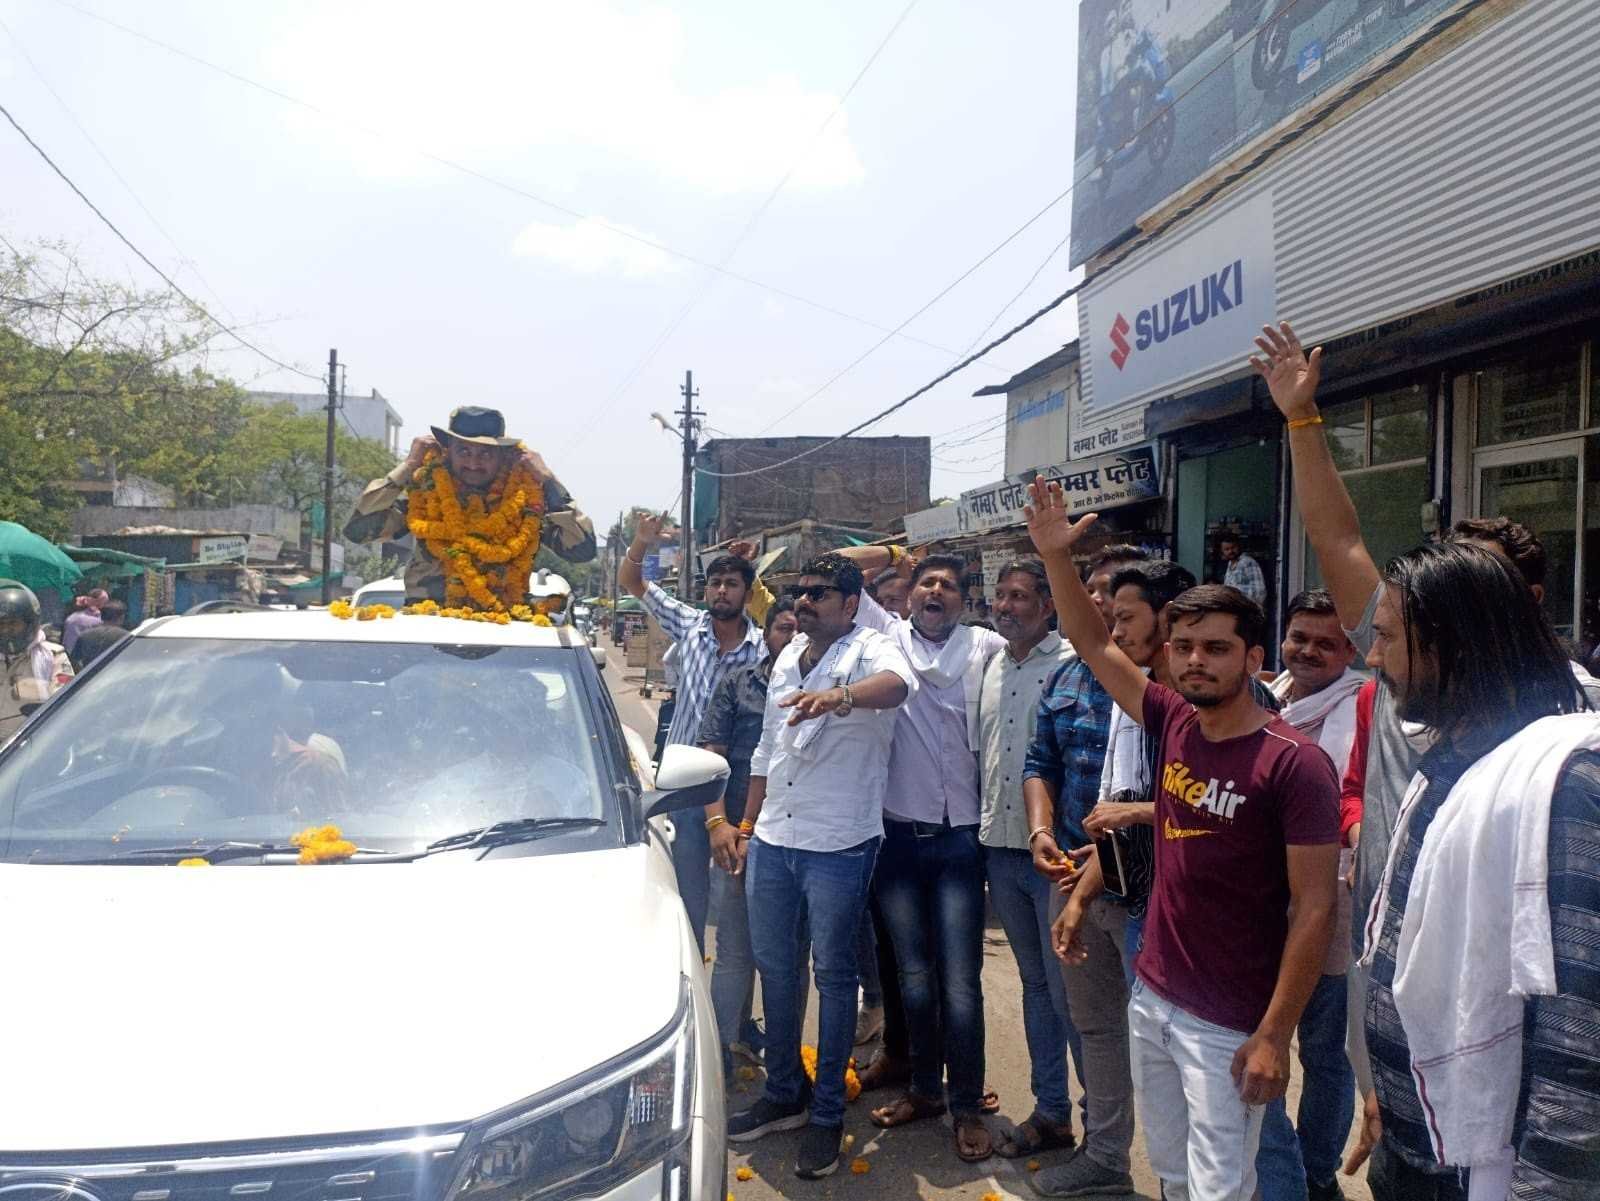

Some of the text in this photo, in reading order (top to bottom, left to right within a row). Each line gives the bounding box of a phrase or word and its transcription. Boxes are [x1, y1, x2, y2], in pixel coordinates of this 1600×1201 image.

[1136, 259, 1242, 351] SUZUKI
[1098, 427, 1119, 446] प्लेट
[1104, 457, 1151, 485] प्लेट
